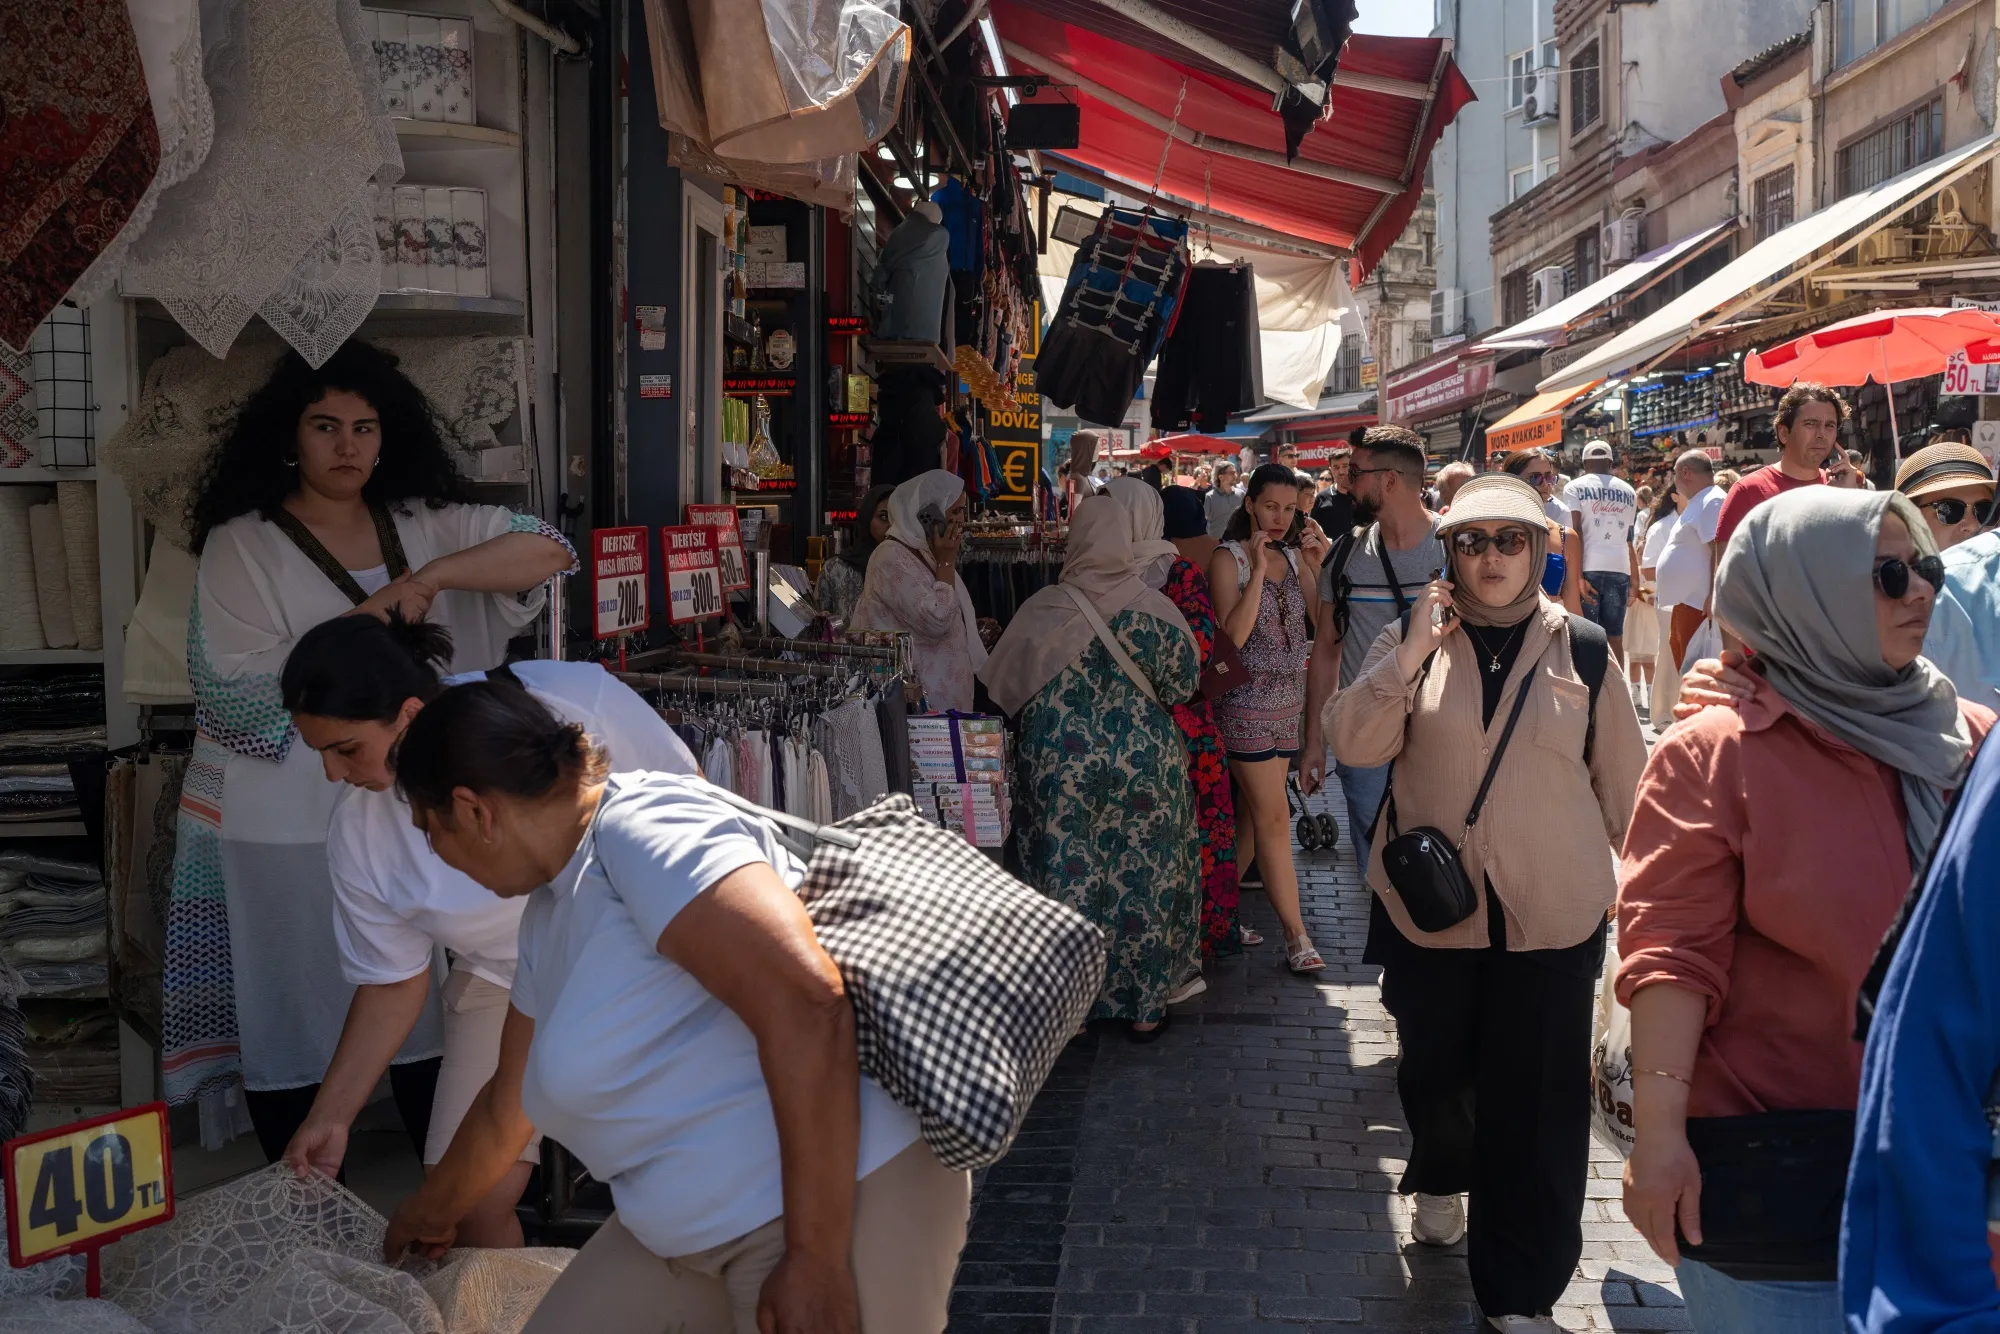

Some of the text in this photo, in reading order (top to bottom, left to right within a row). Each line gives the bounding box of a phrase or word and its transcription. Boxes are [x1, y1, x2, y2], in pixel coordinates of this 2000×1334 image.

[1946, 363, 1981, 393] 50 TL
[1510, 424, 1545, 446] AYAKKABI
[1592, 501, 1626, 514] Oakland
[602, 534, 636, 553] DERTSİZ
[672, 531, 707, 549] DERTSİZ
[597, 553, 643, 577] MASA ÖRTÜSÜ
[668, 548, 714, 569] MASA ÖRTÜSÜ
[718, 548, 738, 585] 50
[617, 578, 639, 627] 200
[691, 571, 714, 614] 300
[1598, 1078, 1633, 1129] Ba
[29, 1133, 166, 1237] 40 TL
